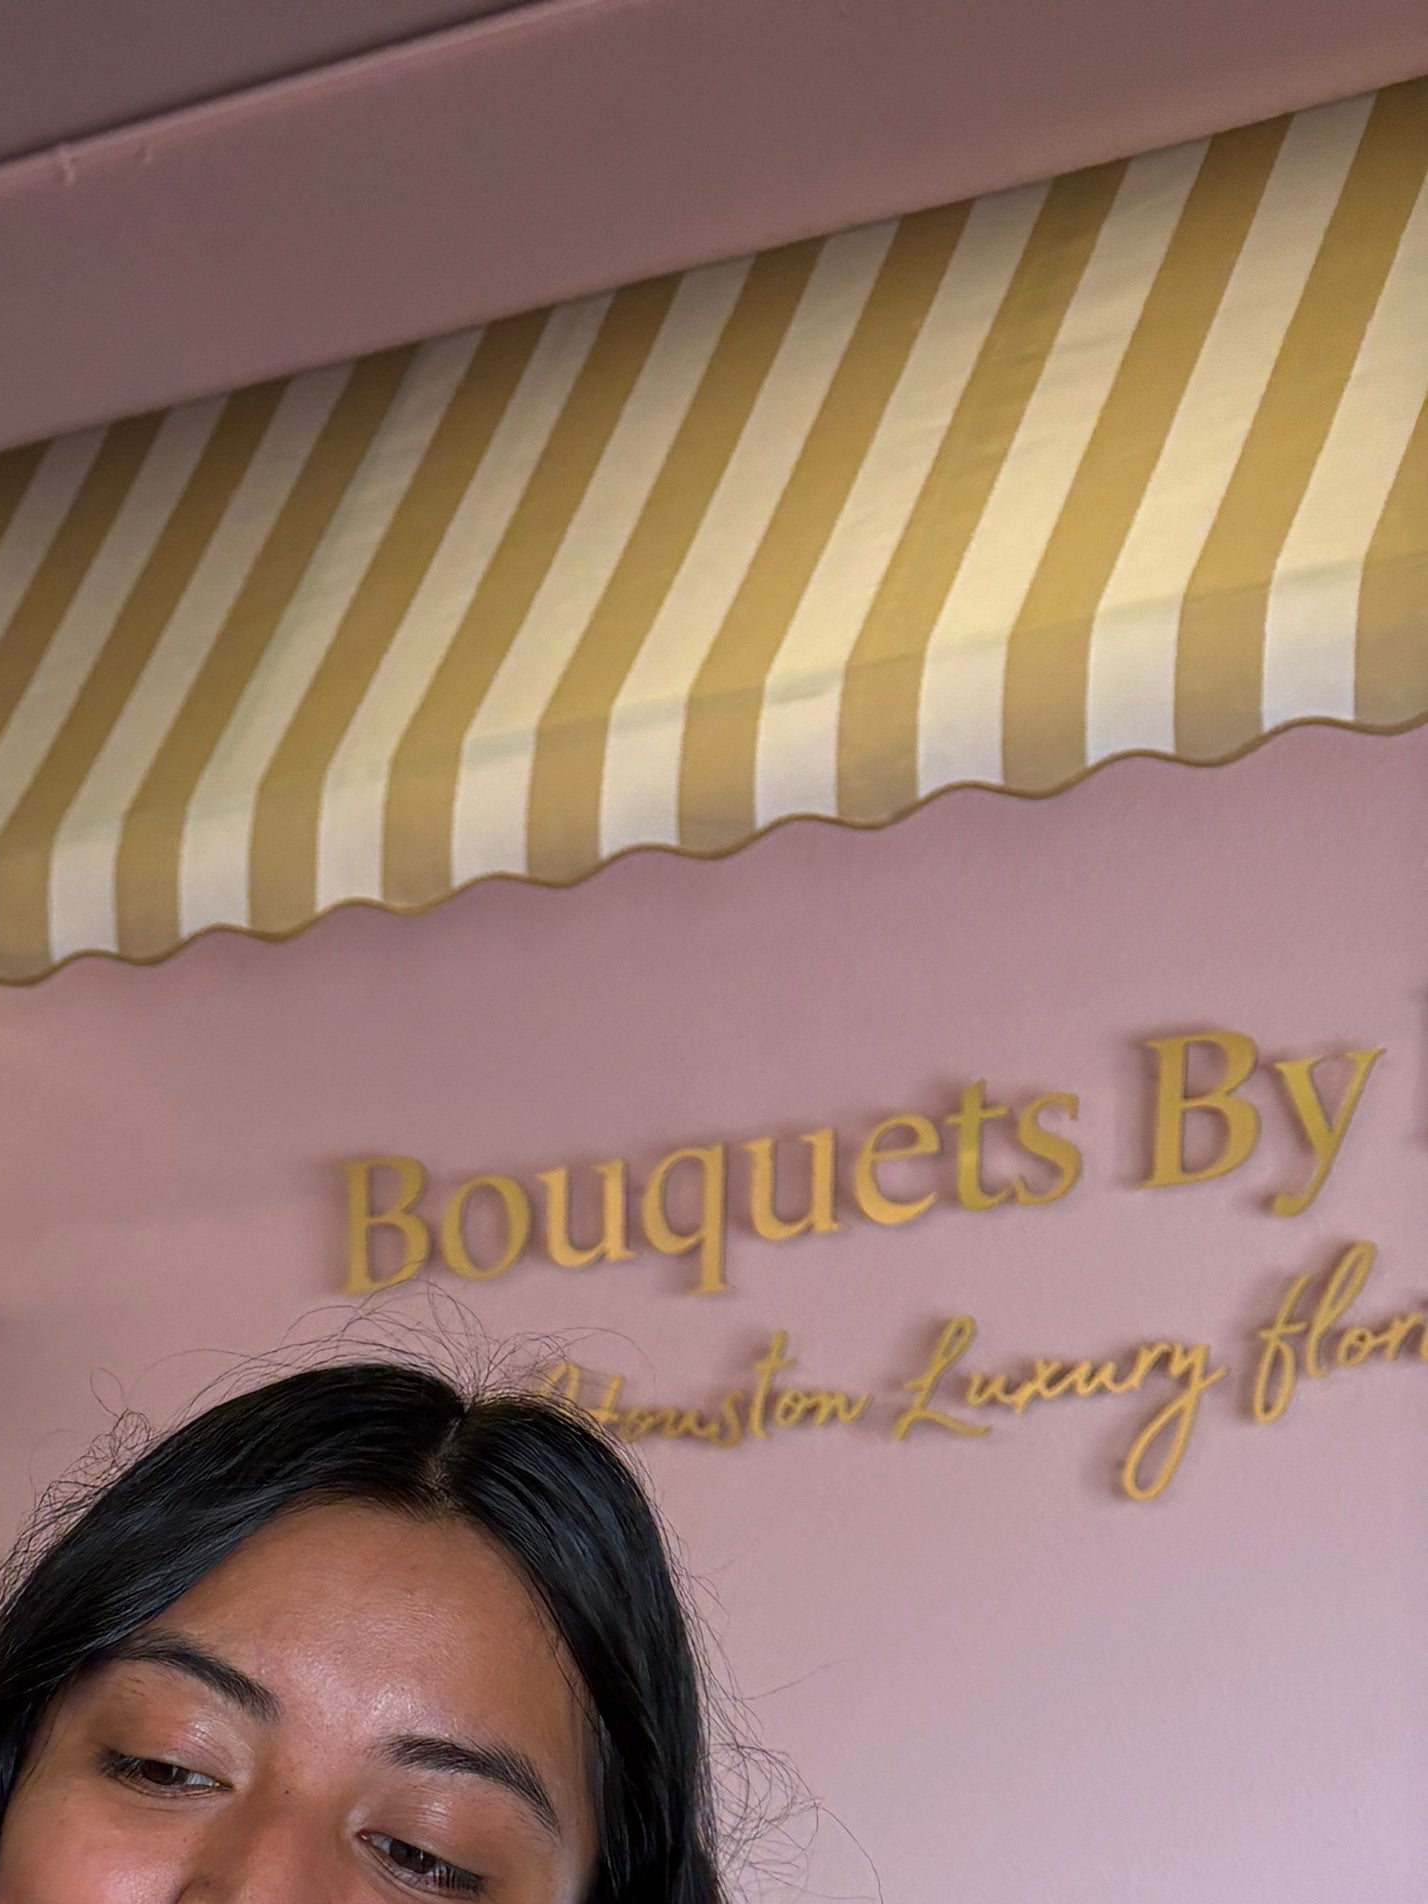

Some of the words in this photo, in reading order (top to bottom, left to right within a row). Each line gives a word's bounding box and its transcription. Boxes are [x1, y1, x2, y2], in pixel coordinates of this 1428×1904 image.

[341, 1077, 1082, 1297] Bouquets
[1138, 1030, 1388, 1218] By
[893, 1315, 1230, 1501] Luxury
